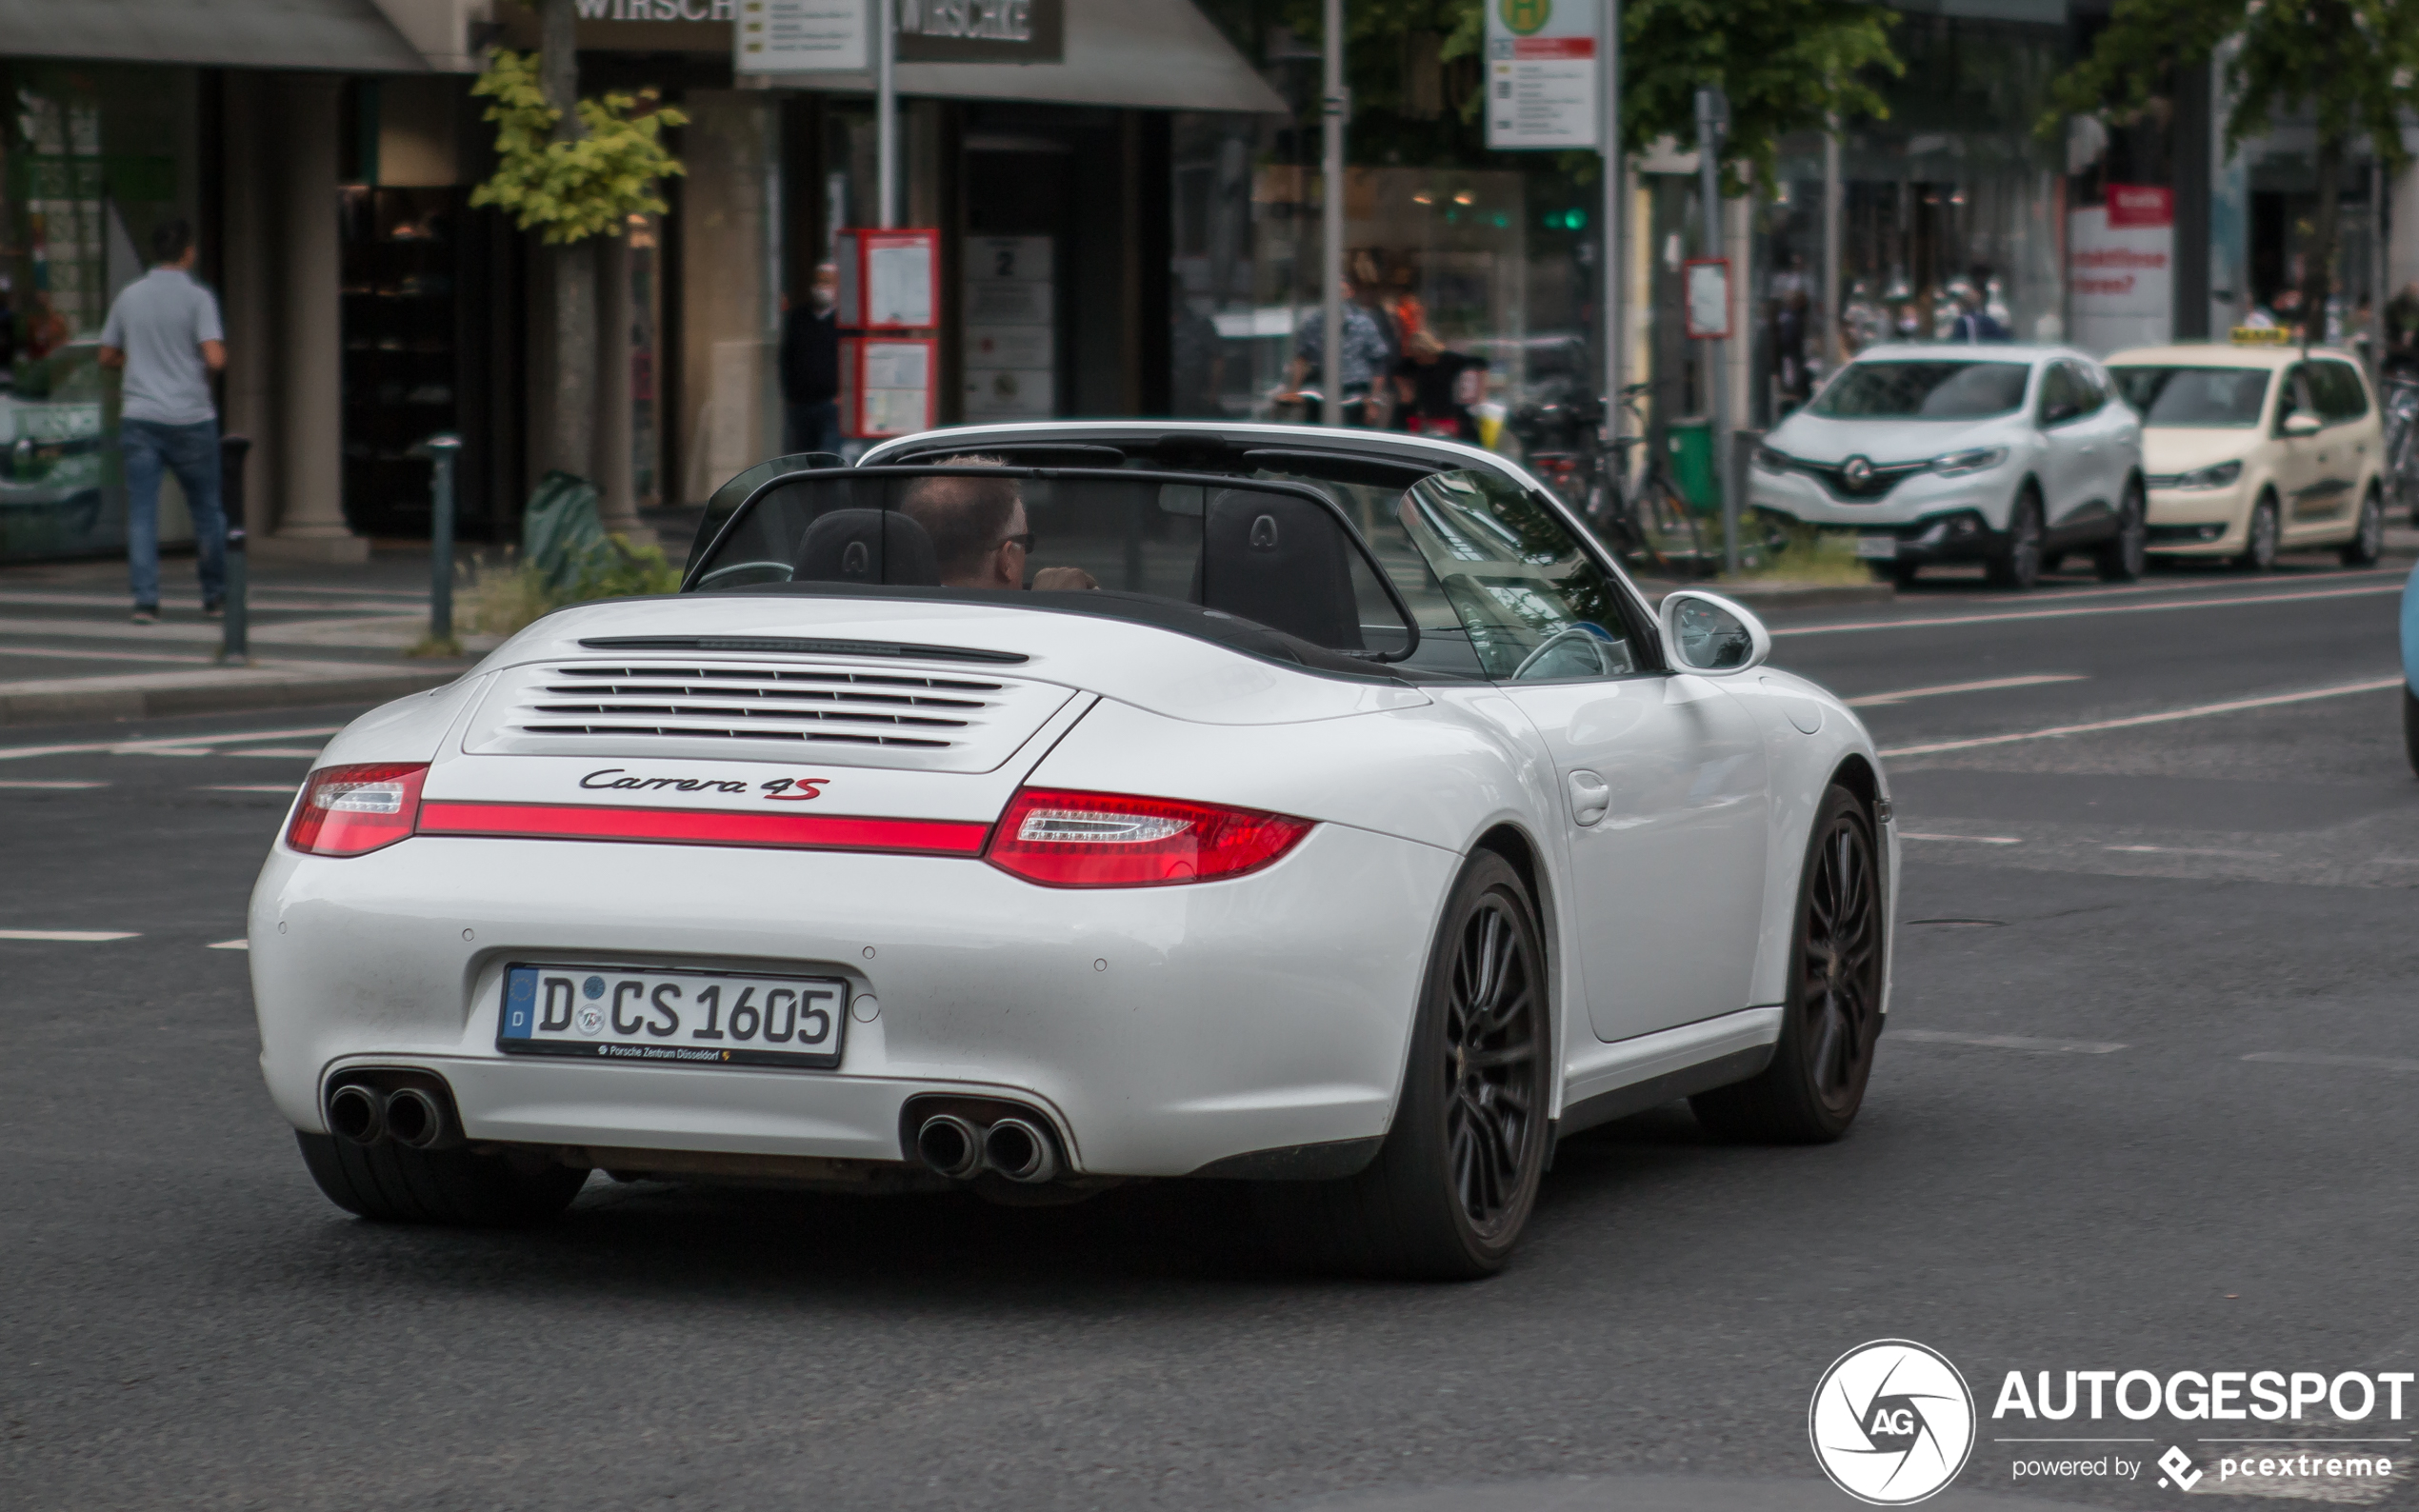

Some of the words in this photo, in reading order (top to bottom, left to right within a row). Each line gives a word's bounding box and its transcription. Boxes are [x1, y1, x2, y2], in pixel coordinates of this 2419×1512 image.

[579, 768, 748, 793] Carrera
[760, 778, 830, 801] 4S
[511, 1011, 525, 1027] D
[539, 977, 574, 1031] D
[611, 981, 682, 1037] CS
[692, 985, 833, 1044] 1605
[610, 1044, 642, 1058] Porsche
[643, 1046, 675, 1059] Zentrum
[676, 1048, 720, 1061] Düsseldorf
